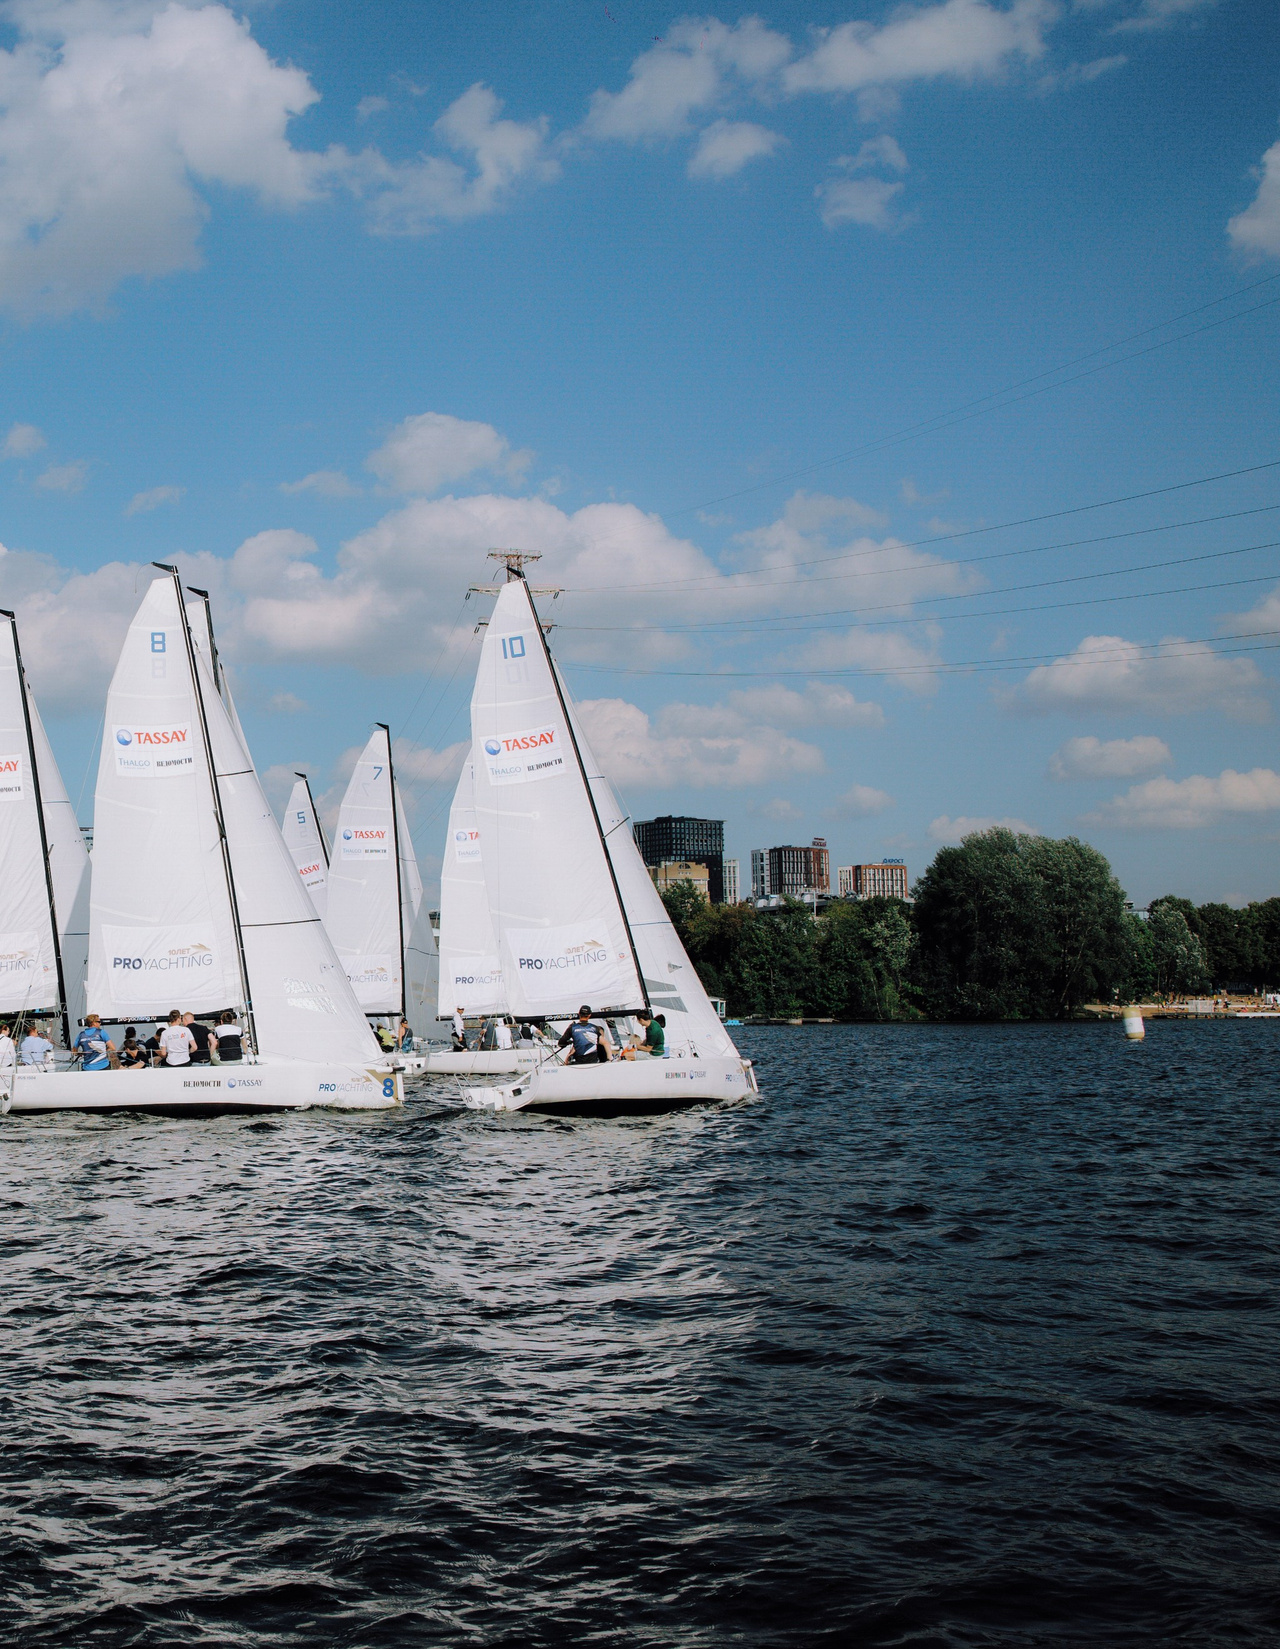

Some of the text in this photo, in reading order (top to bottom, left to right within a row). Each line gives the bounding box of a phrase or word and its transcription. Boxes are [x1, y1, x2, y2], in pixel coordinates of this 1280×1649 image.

[151, 632, 166, 652] 8
[502, 636, 526, 659] 10
[134, 729, 187, 744] TASSAY
[502, 731, 554, 752] TASSAY
[118, 758, 150, 767] THALGO
[373, 766, 383, 780] 7
[297, 811, 306, 824] 5
[354, 831, 386, 839] TASSAY
[300, 864, 320, 875] ASSAY
[113, 954, 213, 970] PROYACHTING
[520, 950, 607, 970] PROYACHTING
[456, 976, 503, 985] PROYACHT
[382, 1078, 394, 1097] 8
